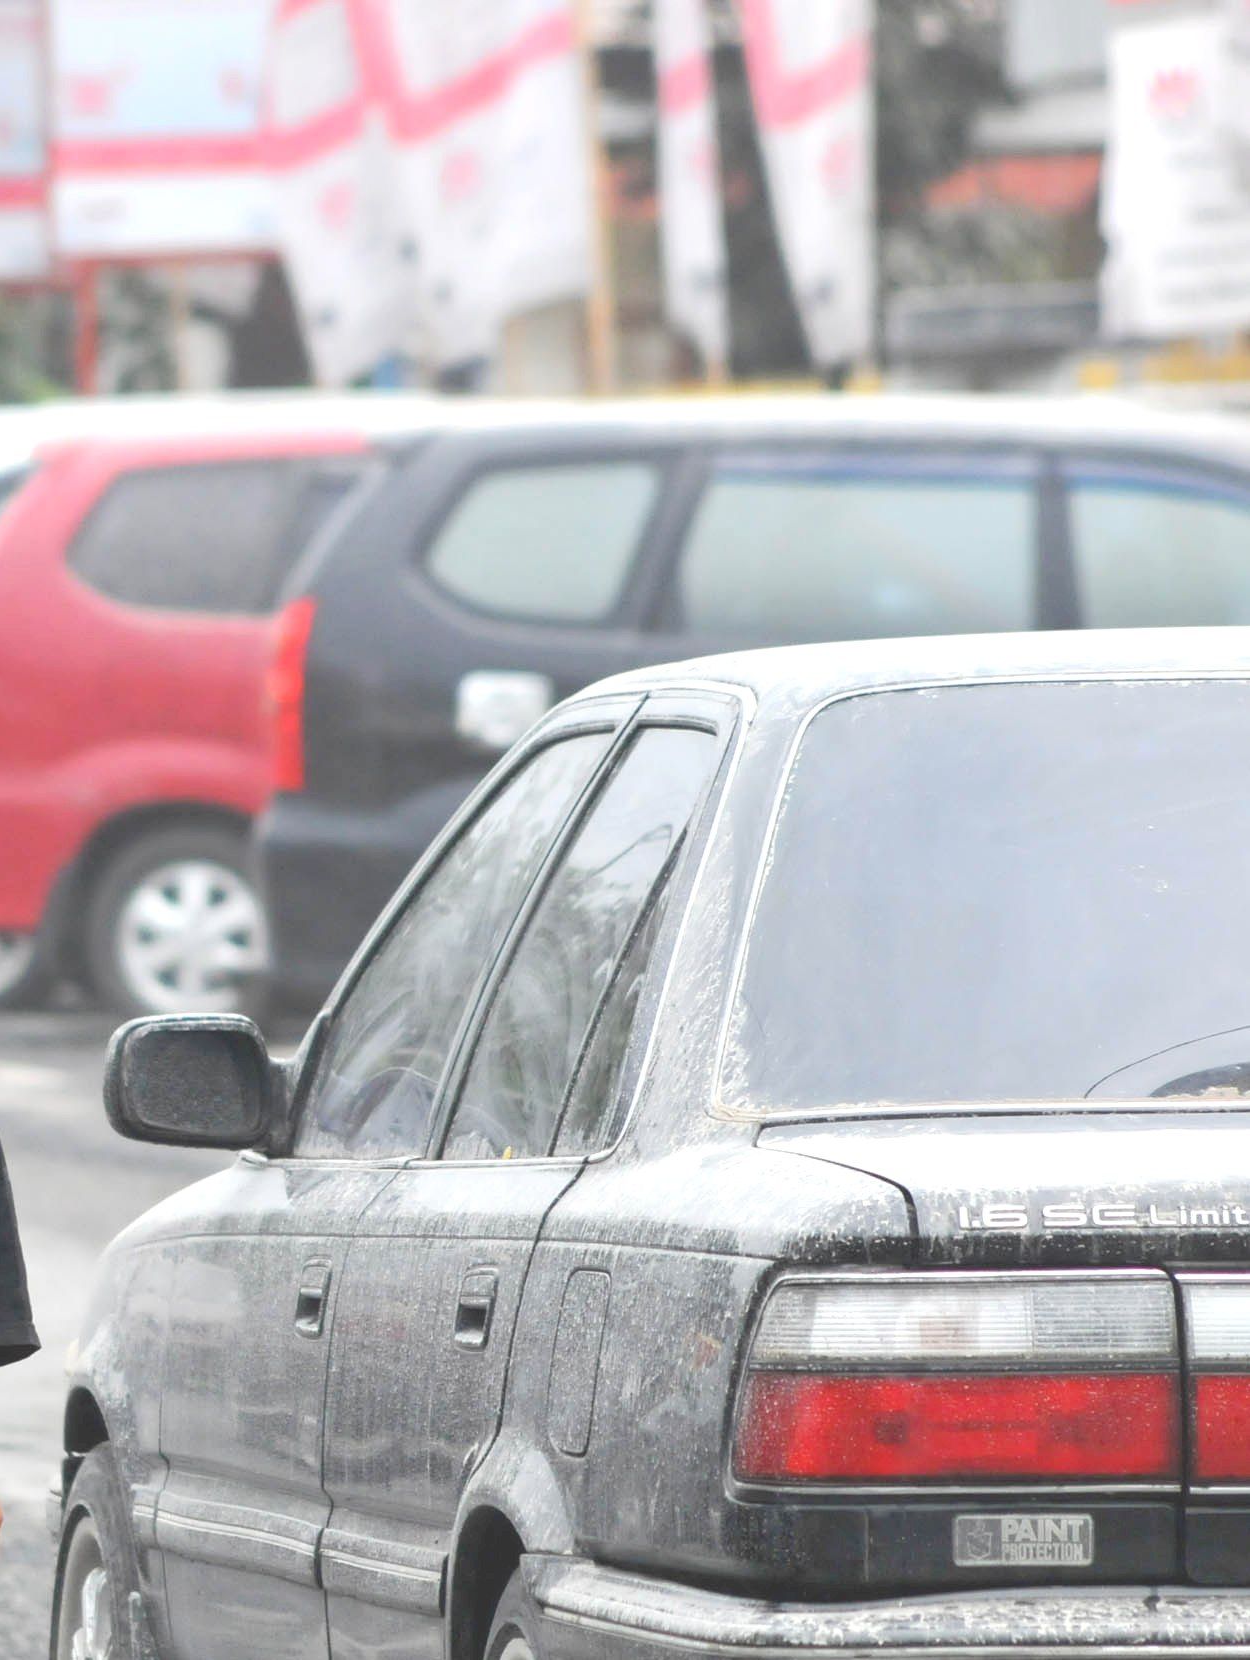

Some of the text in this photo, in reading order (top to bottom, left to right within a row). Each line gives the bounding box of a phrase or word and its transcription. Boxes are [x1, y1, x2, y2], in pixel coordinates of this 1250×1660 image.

[958, 1204, 1028, 1229] 1.6
[1042, 1203, 1136, 1227] SE
[1001, 1518, 1084, 1542] PAINT
[1001, 1542, 1084, 1562] PROTECTION
